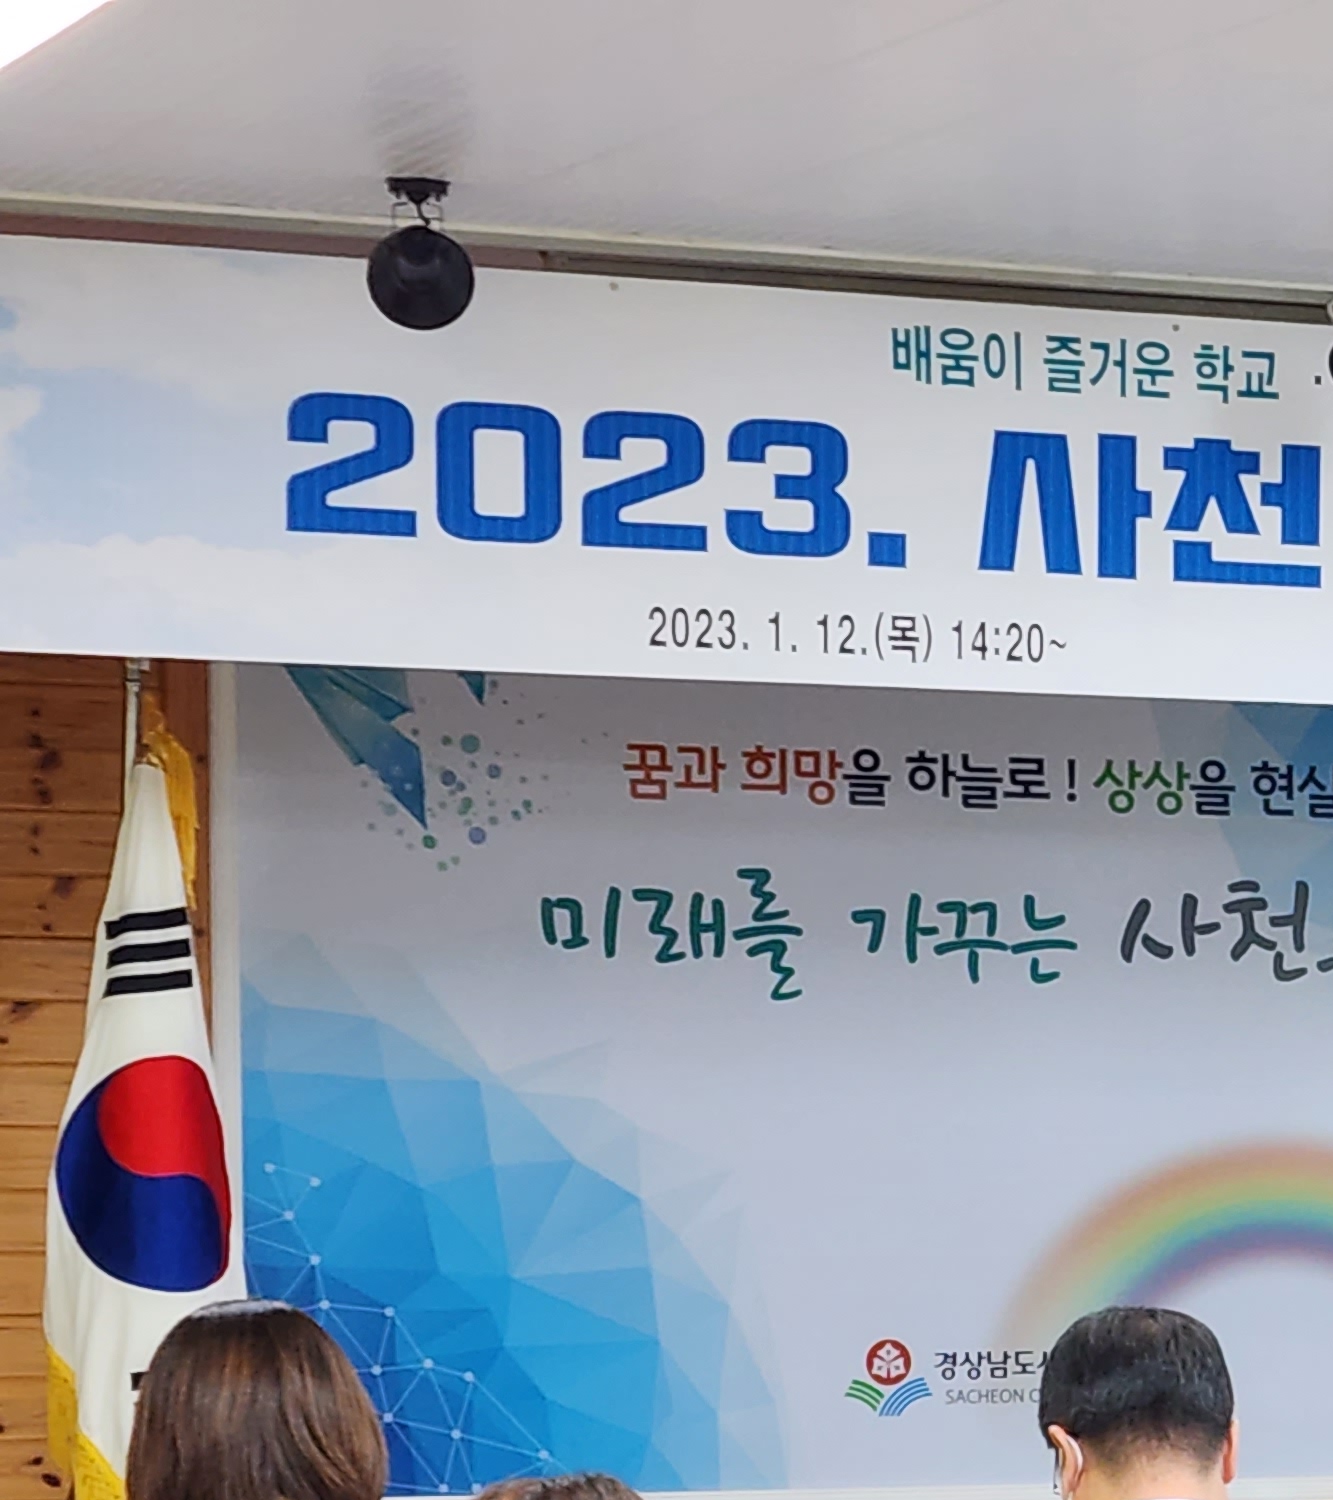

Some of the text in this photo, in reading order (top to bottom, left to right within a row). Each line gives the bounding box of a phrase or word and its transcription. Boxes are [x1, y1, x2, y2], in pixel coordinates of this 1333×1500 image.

[890, 325, 1023, 391] 배움이
[1043, 335, 1175, 399] 즐거운
[1193, 343, 1280, 404] 학교
[286, 391, 907, 569] 2023.
[647, 606, 750, 651] 2023.
[768, 611, 798, 653] 1.
[622, 743, 727, 801] 꿈과
[740, 744, 892, 807] 희망을
[1093, 758, 1237, 817] 상상을
[540, 867, 803, 1001] 미래를
[850, 892, 1078, 984] 가꾸는
[945, 1388, 1025, 1405] SACHEON
